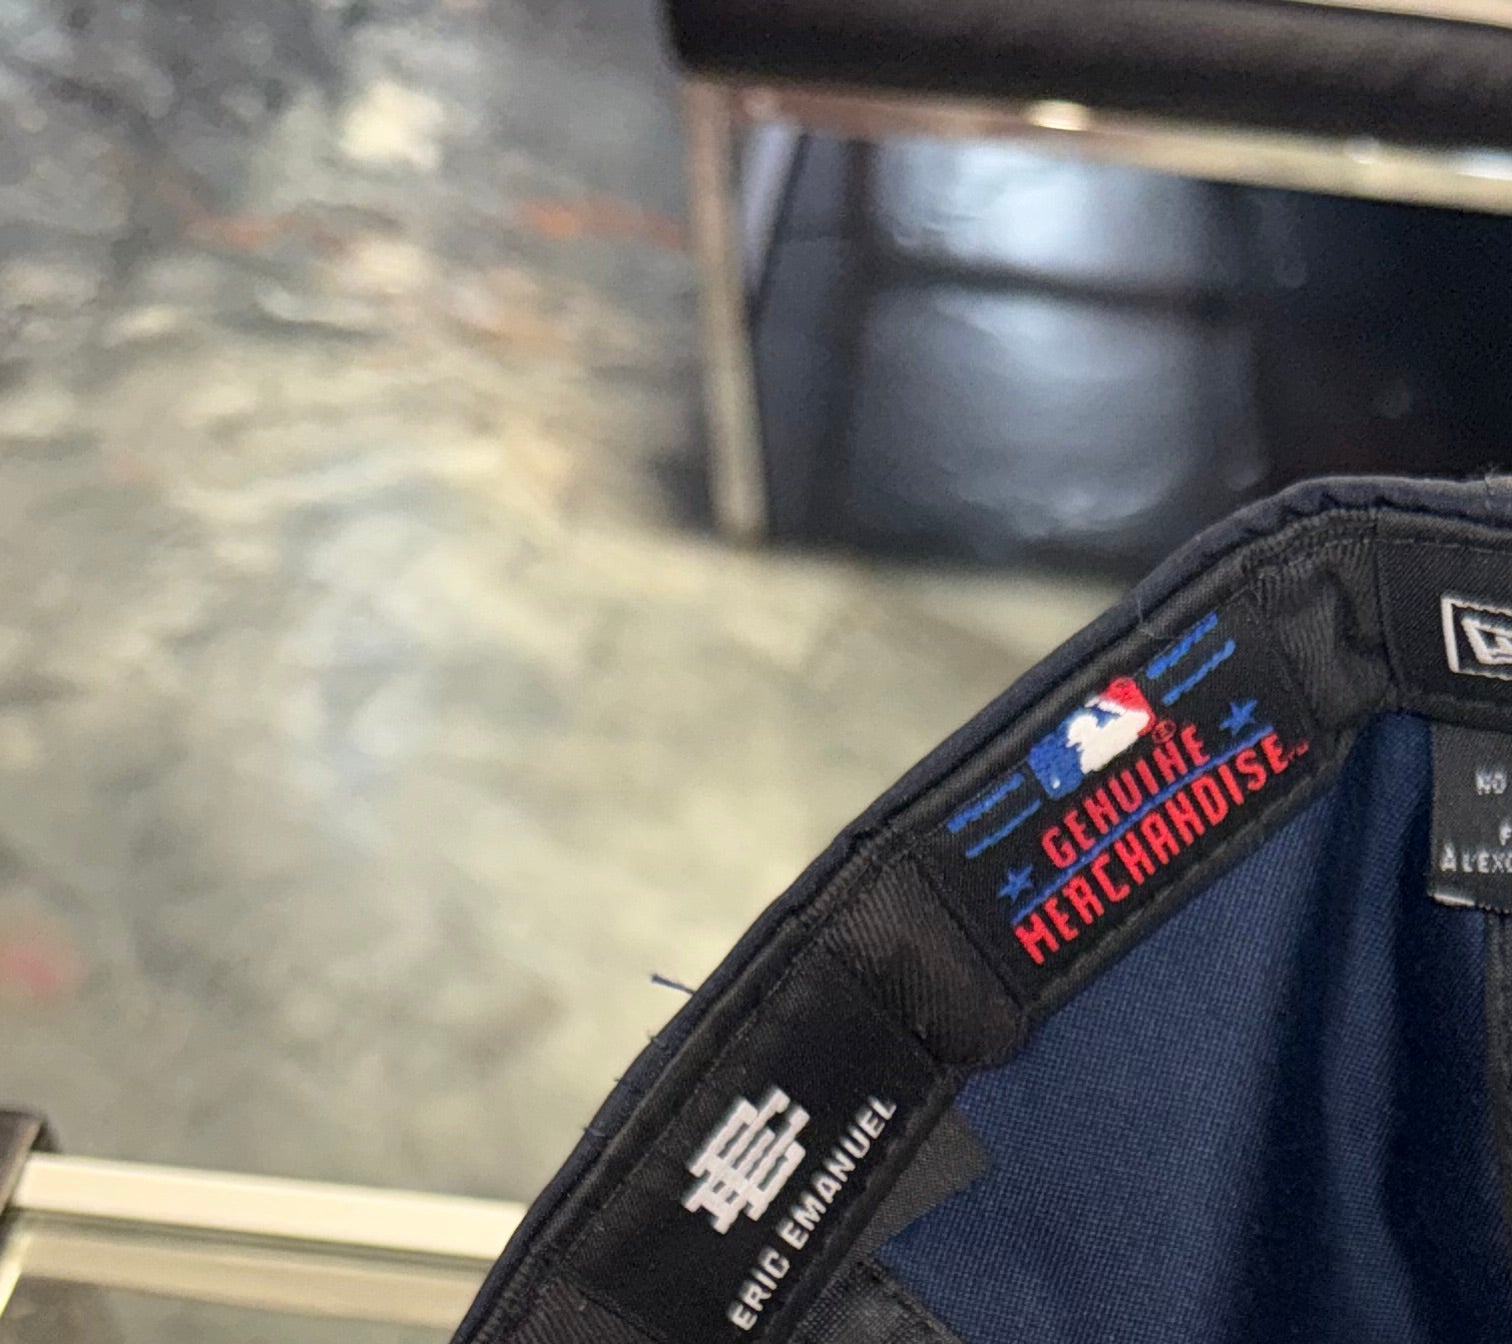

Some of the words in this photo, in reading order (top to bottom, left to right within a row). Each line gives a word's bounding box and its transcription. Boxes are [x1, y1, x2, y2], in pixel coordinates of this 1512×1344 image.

[1013, 731, 1289, 966] MERCHANDISE
[1041, 723, 1211, 869] GENUINE
[1476, 769, 1507, 795] NO
[728, 1250, 791, 1331] ERIC
[777, 1095, 897, 1251] EMANUEL
